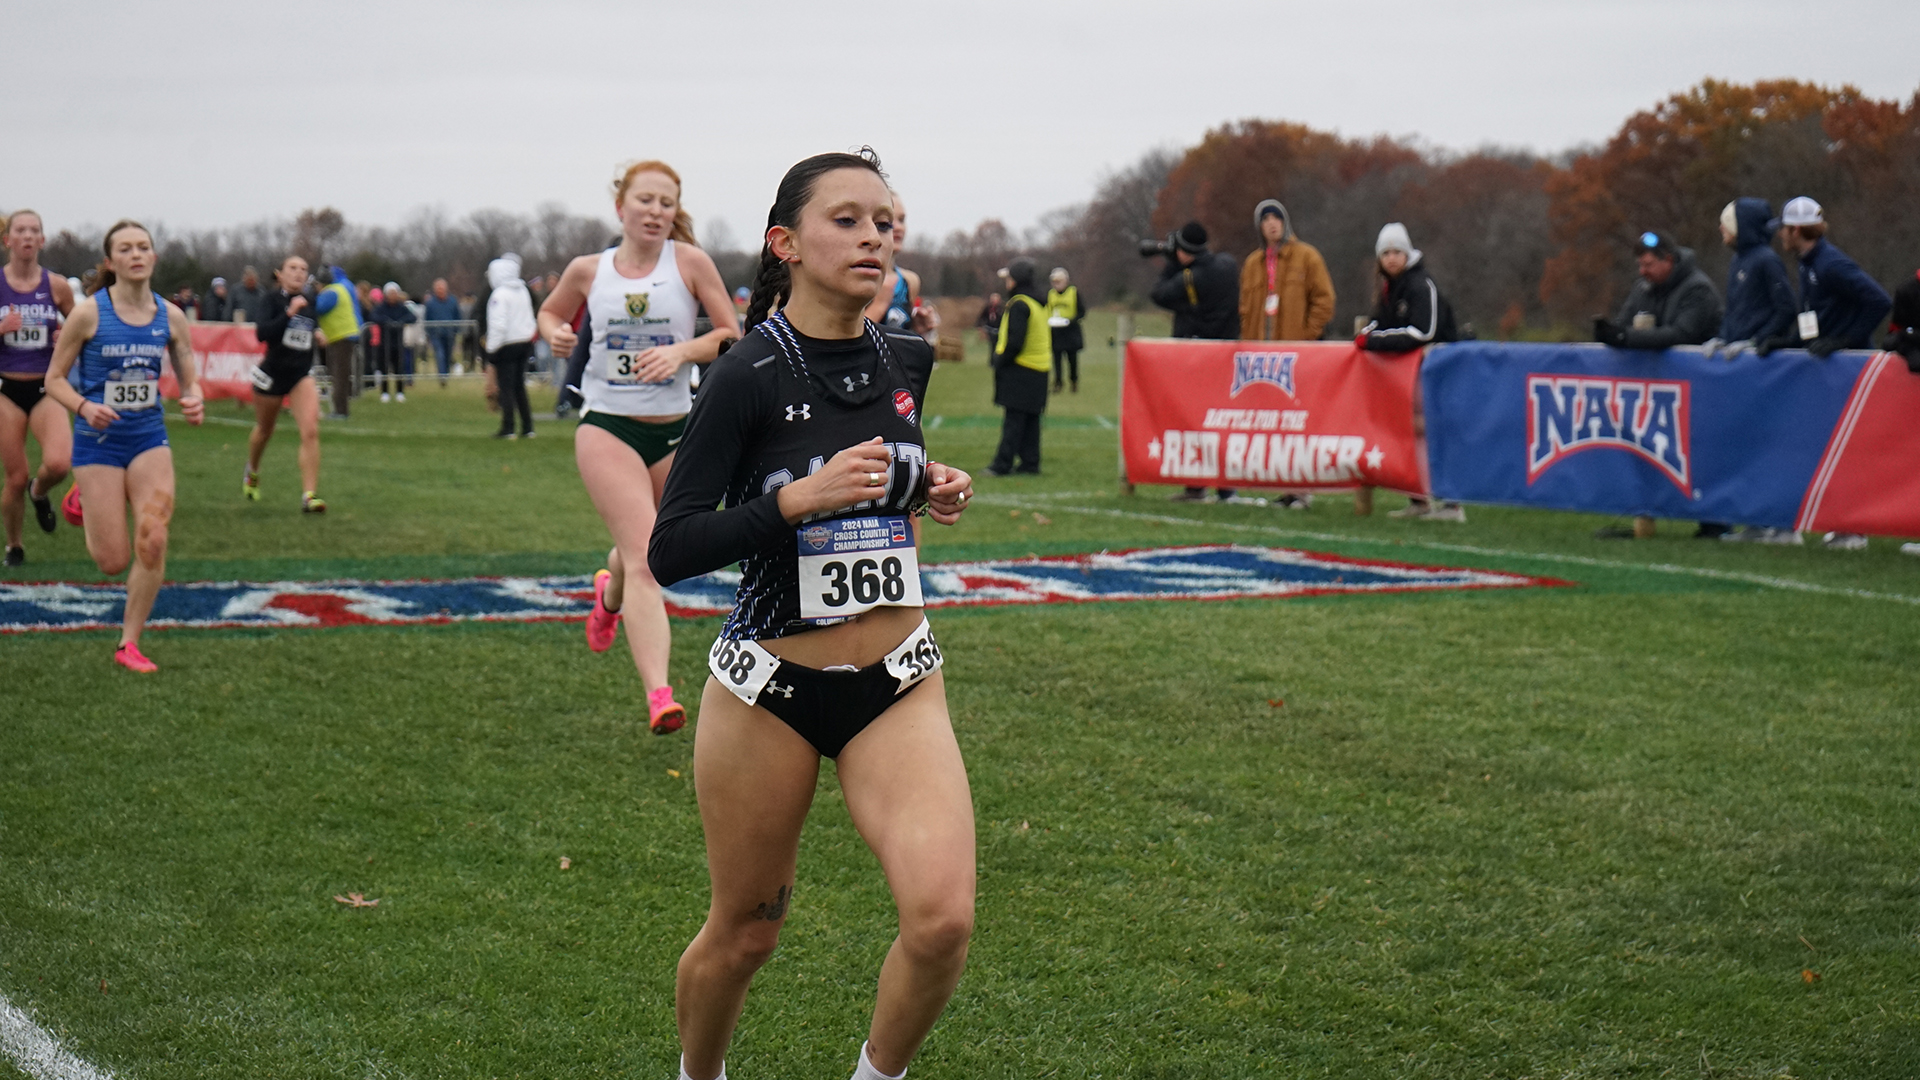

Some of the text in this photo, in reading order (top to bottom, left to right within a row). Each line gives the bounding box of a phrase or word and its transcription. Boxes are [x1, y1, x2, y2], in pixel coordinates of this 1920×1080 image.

[1230, 351, 1299, 400] NAIA
[114, 384, 149, 403] 353
[1203, 408, 1309, 431] BATTLE FOR THE
[1528, 376, 1689, 487] NAIA
[1160, 430, 1366, 482] RED BANNER
[834, 530, 858, 541] CROSS
[859, 528, 890, 540] COUNTRY
[842, 519, 879, 531] 2024 NAIA
[833, 538, 890, 551] CHAMPIONSHIPS
[821, 556, 905, 607] 368
